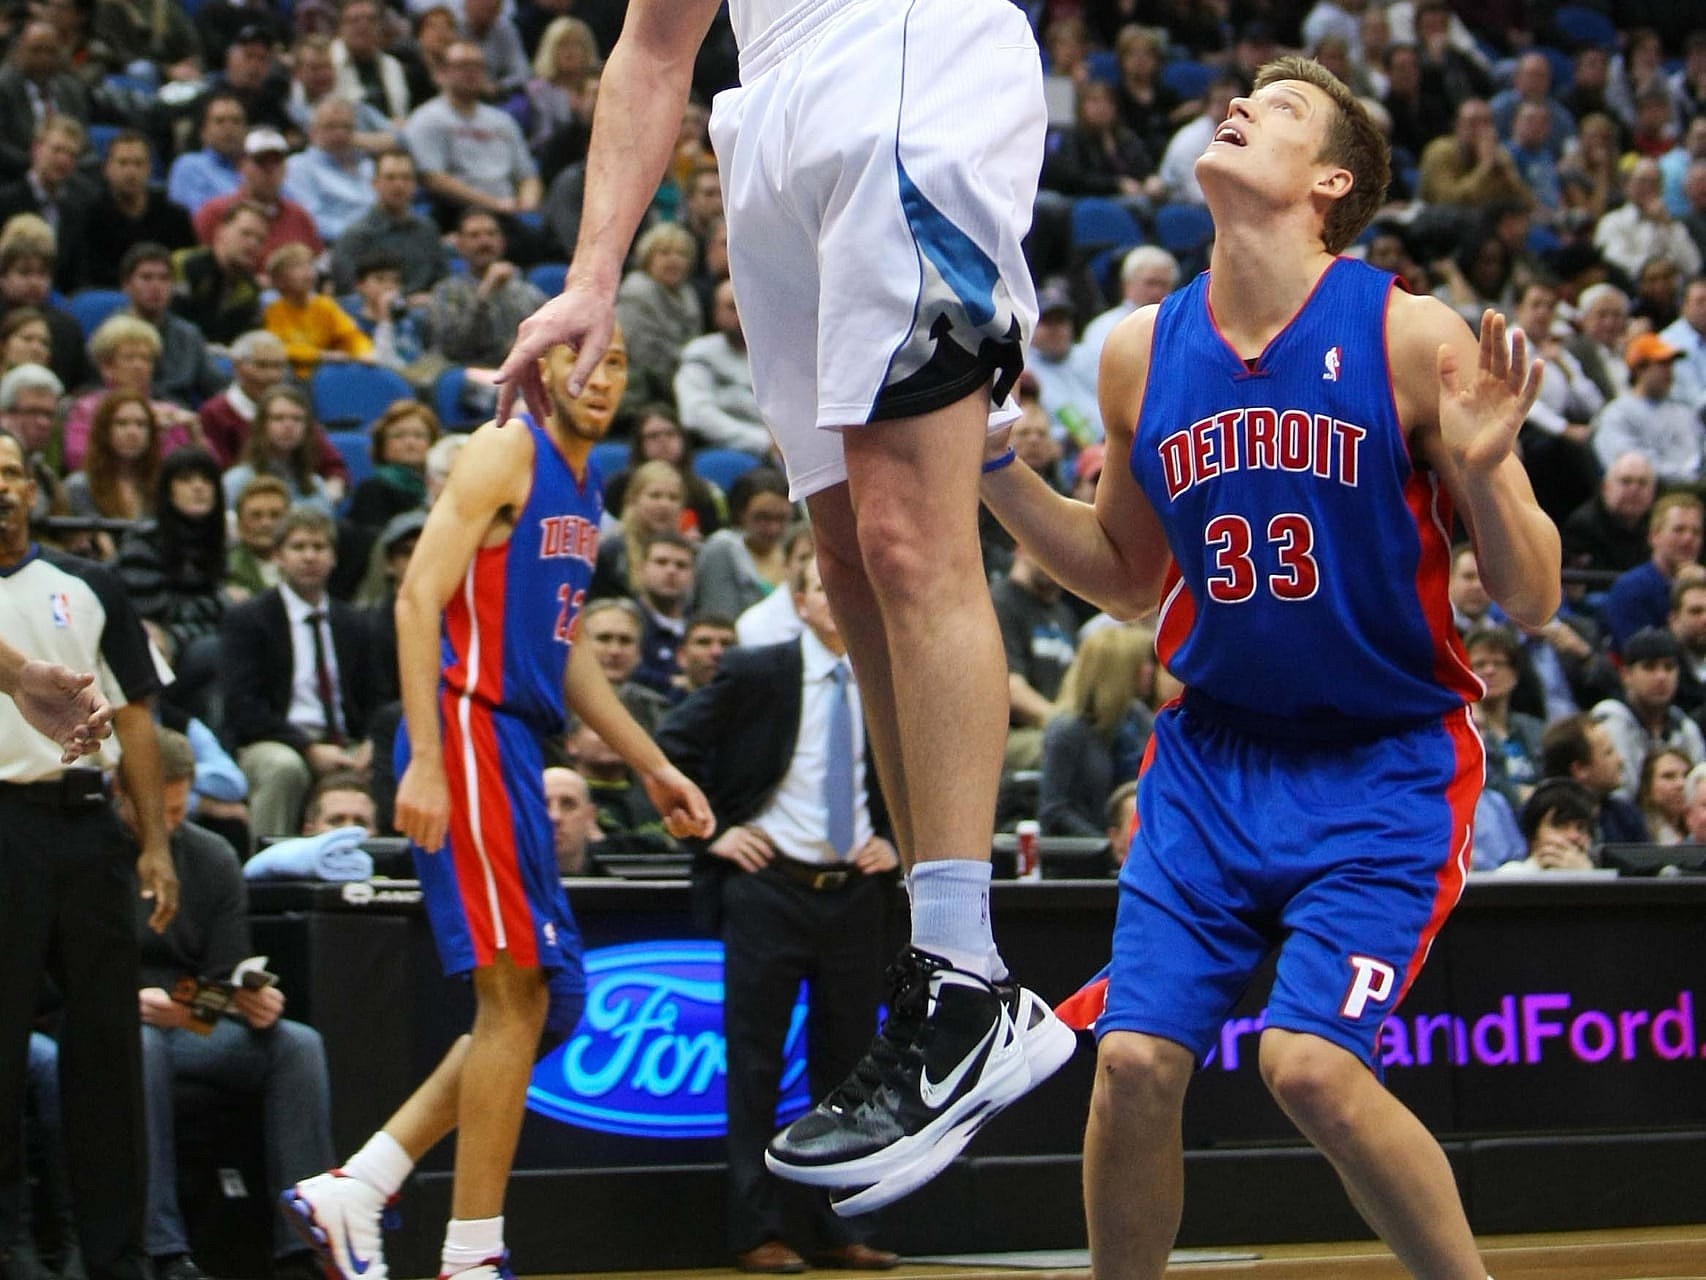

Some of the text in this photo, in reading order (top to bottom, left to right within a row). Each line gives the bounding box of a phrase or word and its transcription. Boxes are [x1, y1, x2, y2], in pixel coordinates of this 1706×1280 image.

[1158, 407, 1367, 503] DETROIT
[1205, 513, 1320, 603] 33
[1340, 952, 1396, 1019] P
[562, 971, 808, 1098] For
